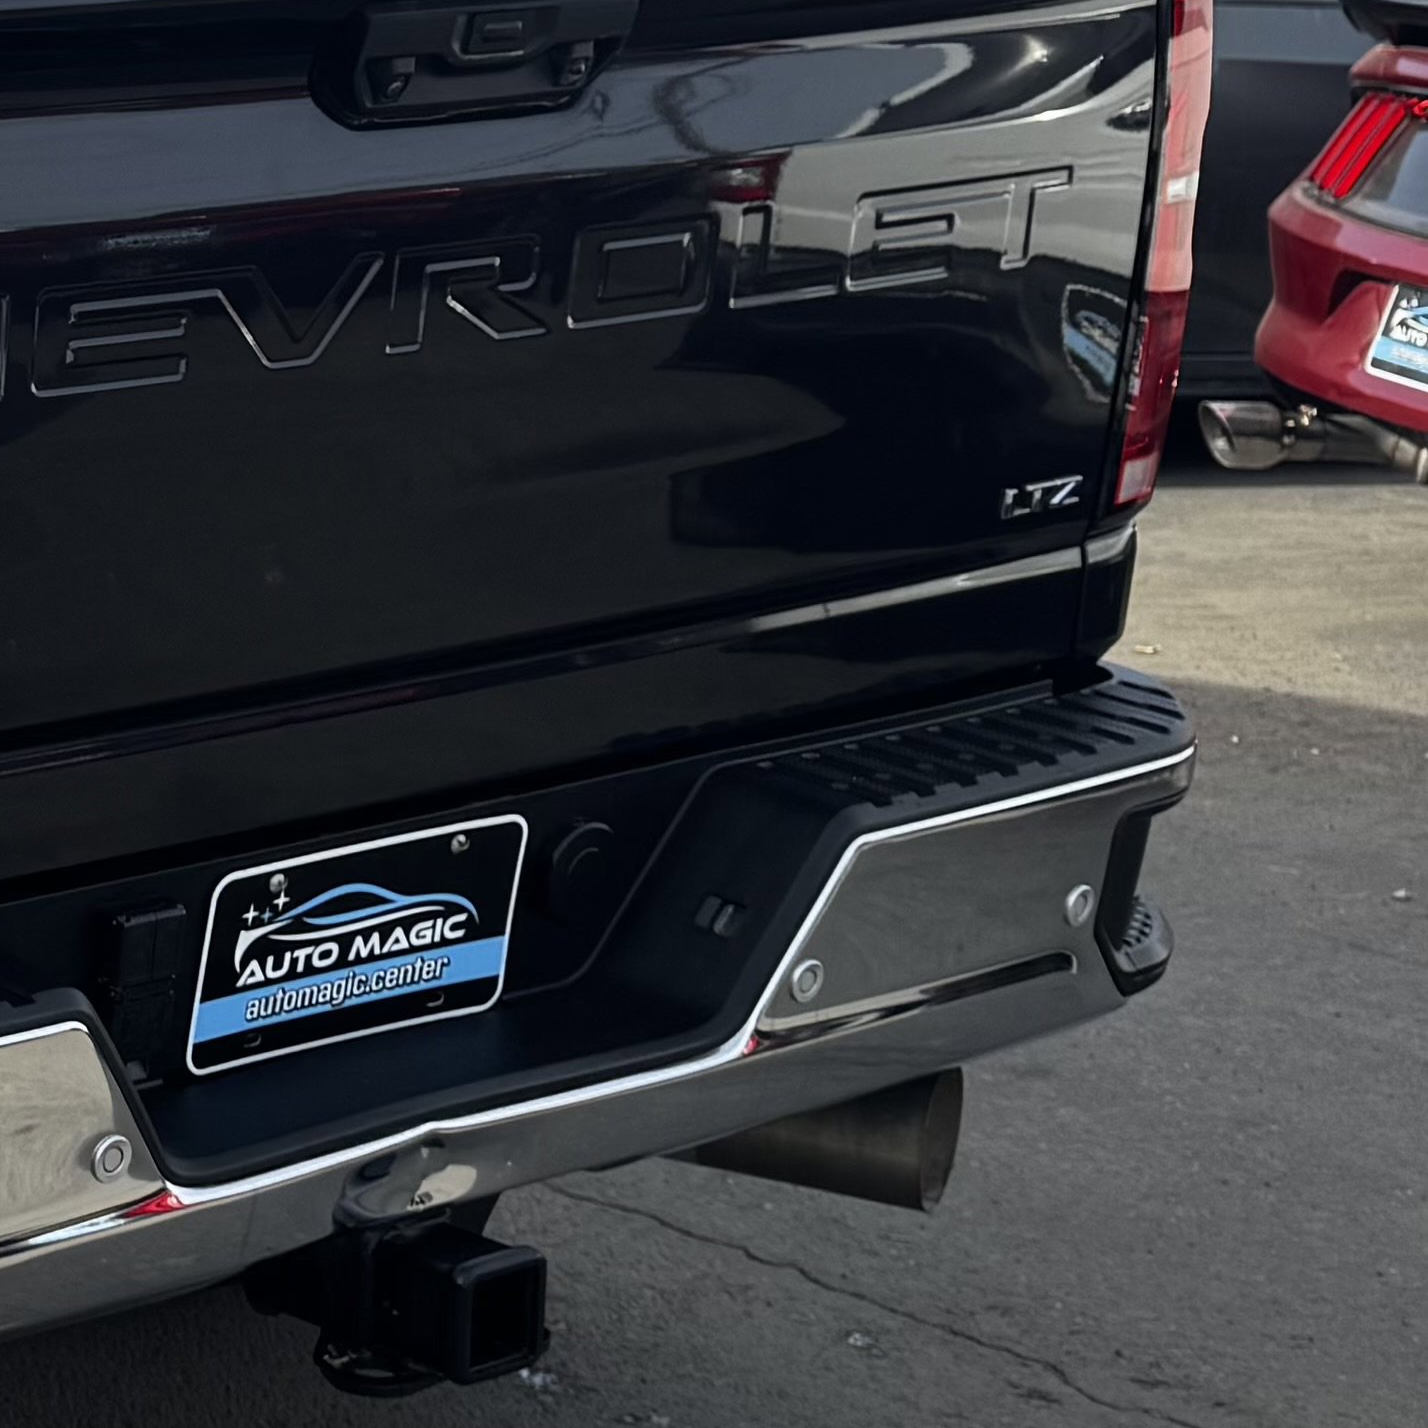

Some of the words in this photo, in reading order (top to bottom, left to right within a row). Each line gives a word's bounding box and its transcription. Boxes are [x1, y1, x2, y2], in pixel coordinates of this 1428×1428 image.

[1001, 475, 1083, 519] LTZ
[236, 940, 339, 988] AUTO
[348, 912, 469, 961] MAGIC
[245, 956, 450, 1021] automagic.center
